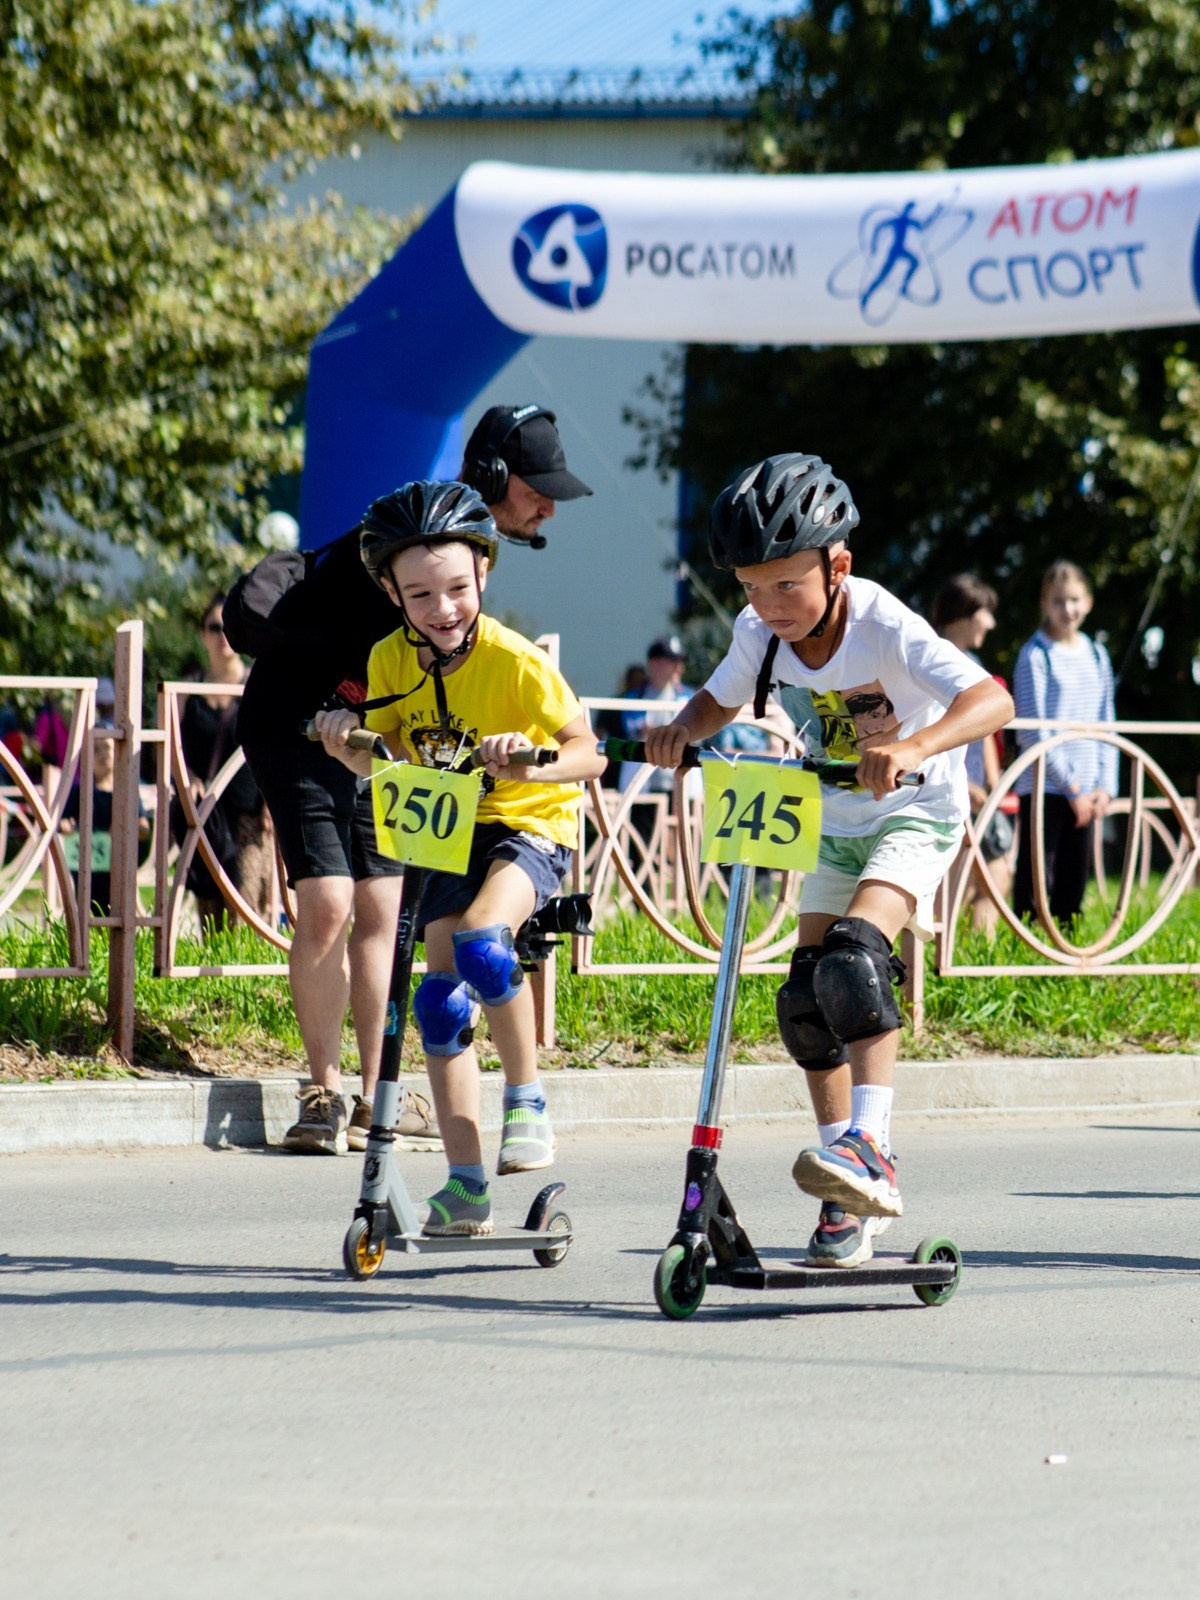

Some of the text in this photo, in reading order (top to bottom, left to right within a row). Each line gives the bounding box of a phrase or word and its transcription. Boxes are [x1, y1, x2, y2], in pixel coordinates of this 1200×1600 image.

[987, 183, 1139, 241] АТОМ
[626, 241, 797, 279] РОСАТОМ
[967, 243, 1146, 305] СПОРТ
[430, 709, 464, 730] LKE
[382, 781, 459, 840] 250
[715, 788, 803, 845] 245
